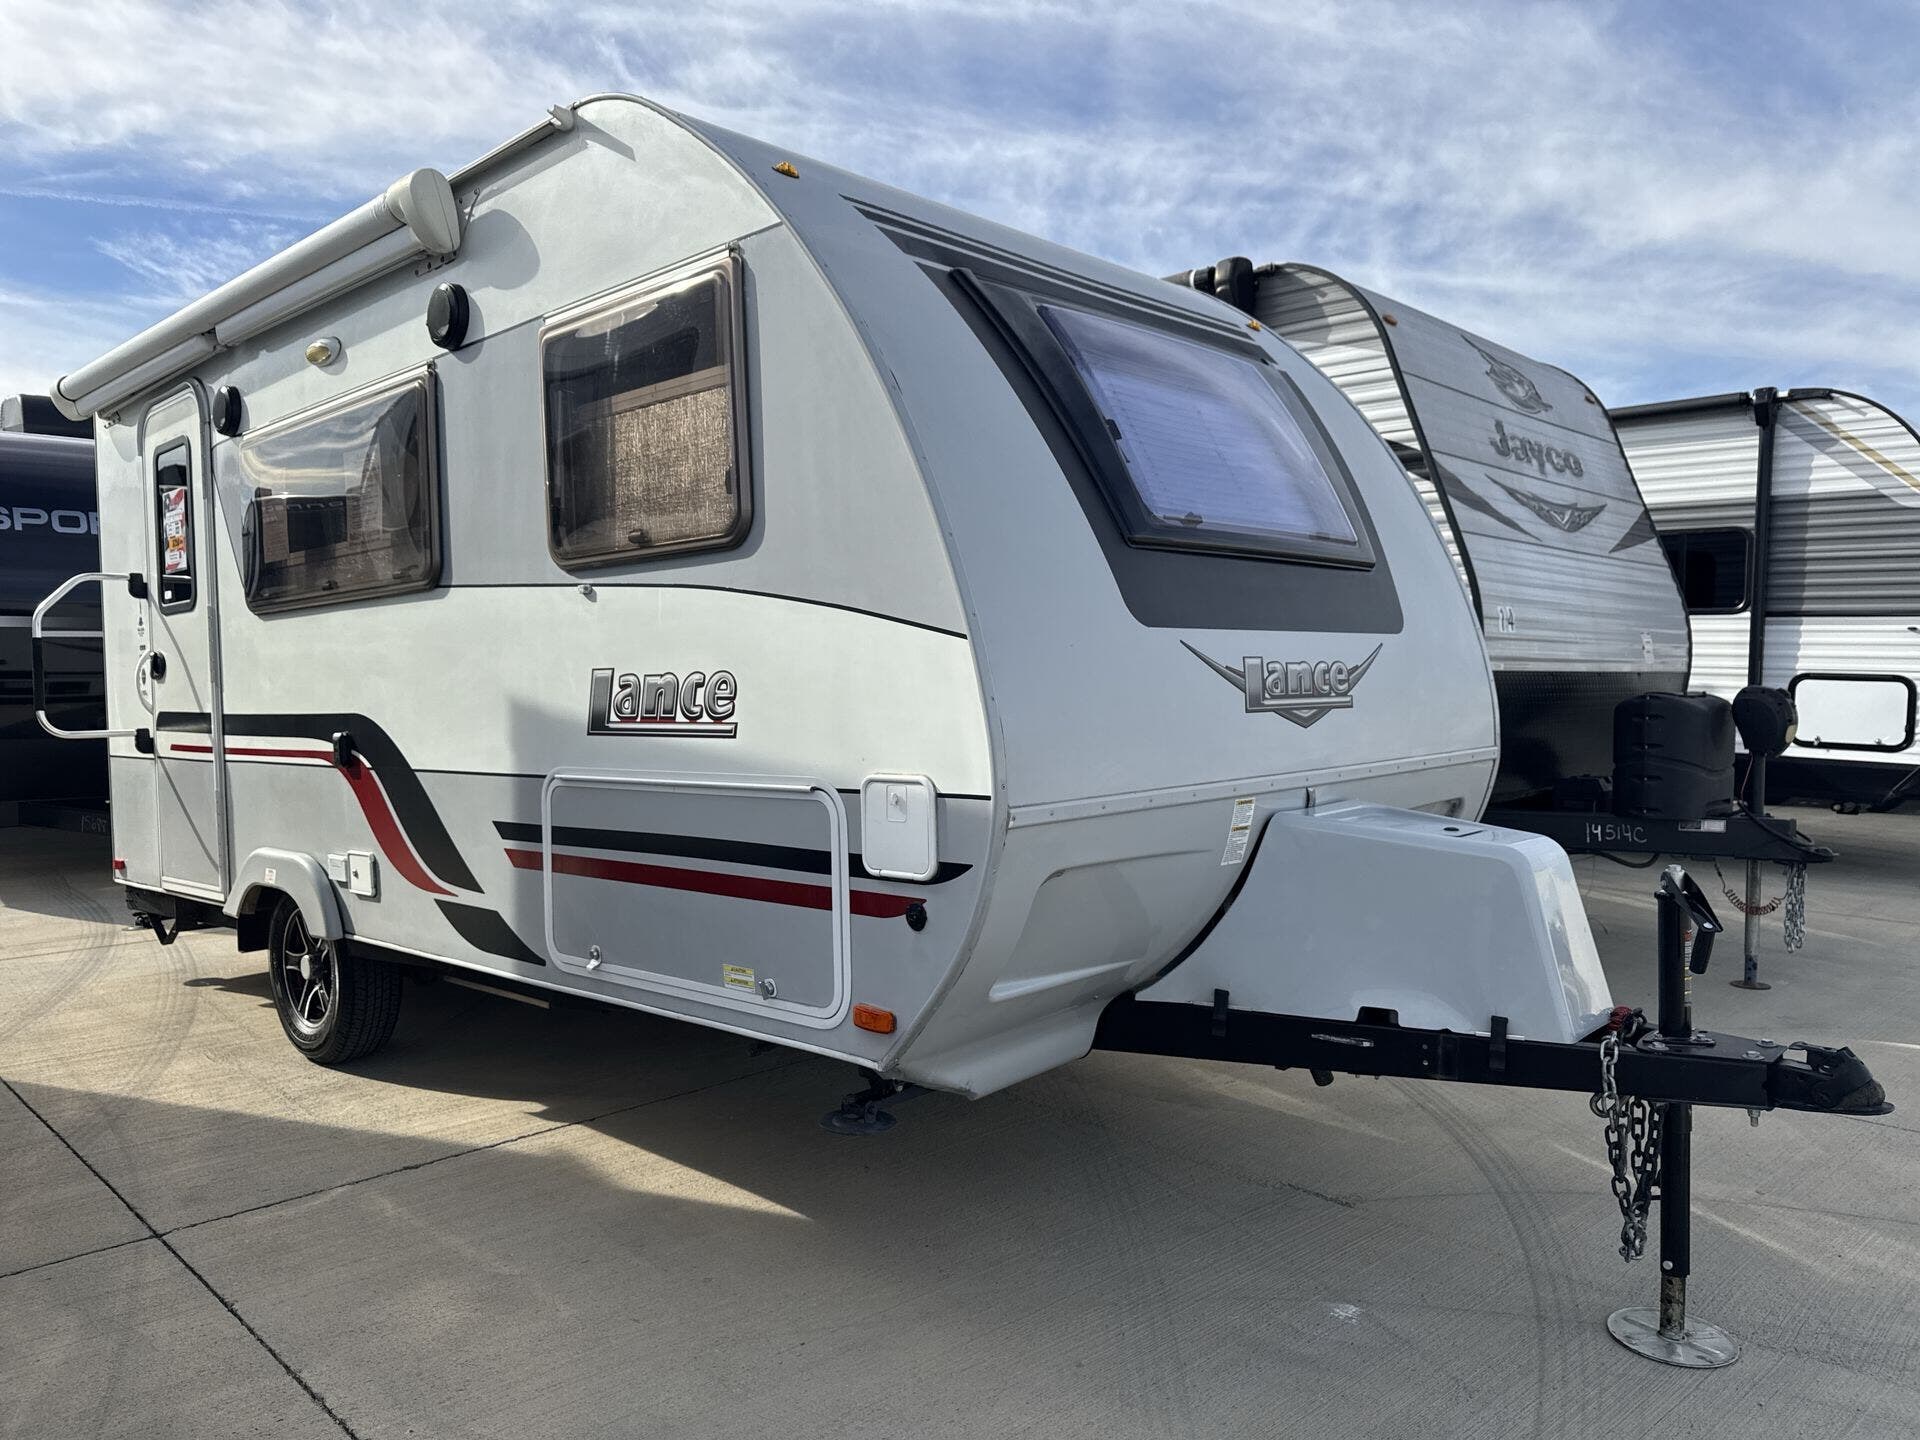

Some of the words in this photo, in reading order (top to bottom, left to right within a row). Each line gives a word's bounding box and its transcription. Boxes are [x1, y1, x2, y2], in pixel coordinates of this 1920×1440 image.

[1489, 418, 1583, 478] Jayco
[1499, 607, 1515, 633] 14
[587, 667, 738, 739] Lance
[1243, 656, 1354, 713] Lance
[1586, 822, 1647, 844] 14514C
